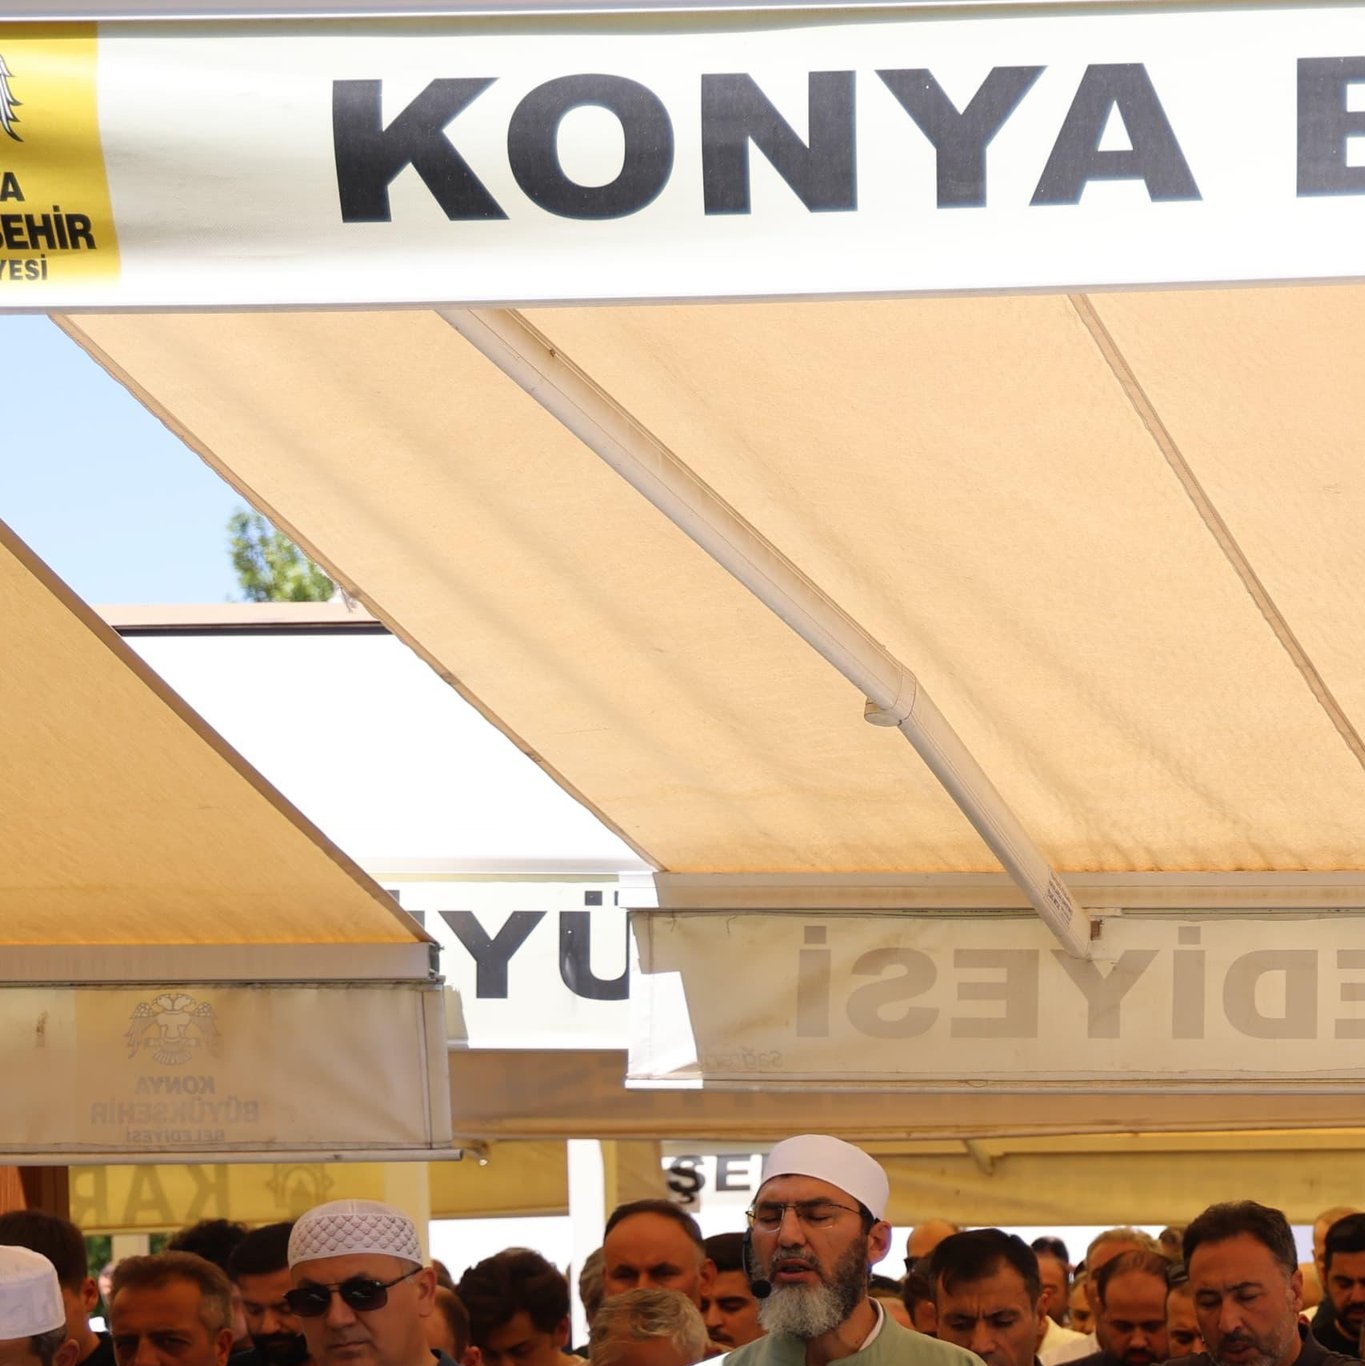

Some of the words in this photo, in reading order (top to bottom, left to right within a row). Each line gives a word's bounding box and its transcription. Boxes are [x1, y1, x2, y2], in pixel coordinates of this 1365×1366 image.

[333, 62, 1204, 224] KONYA
[0, 204, 98, 250] EHİR
[667, 1154, 772, 1204] ŞE
